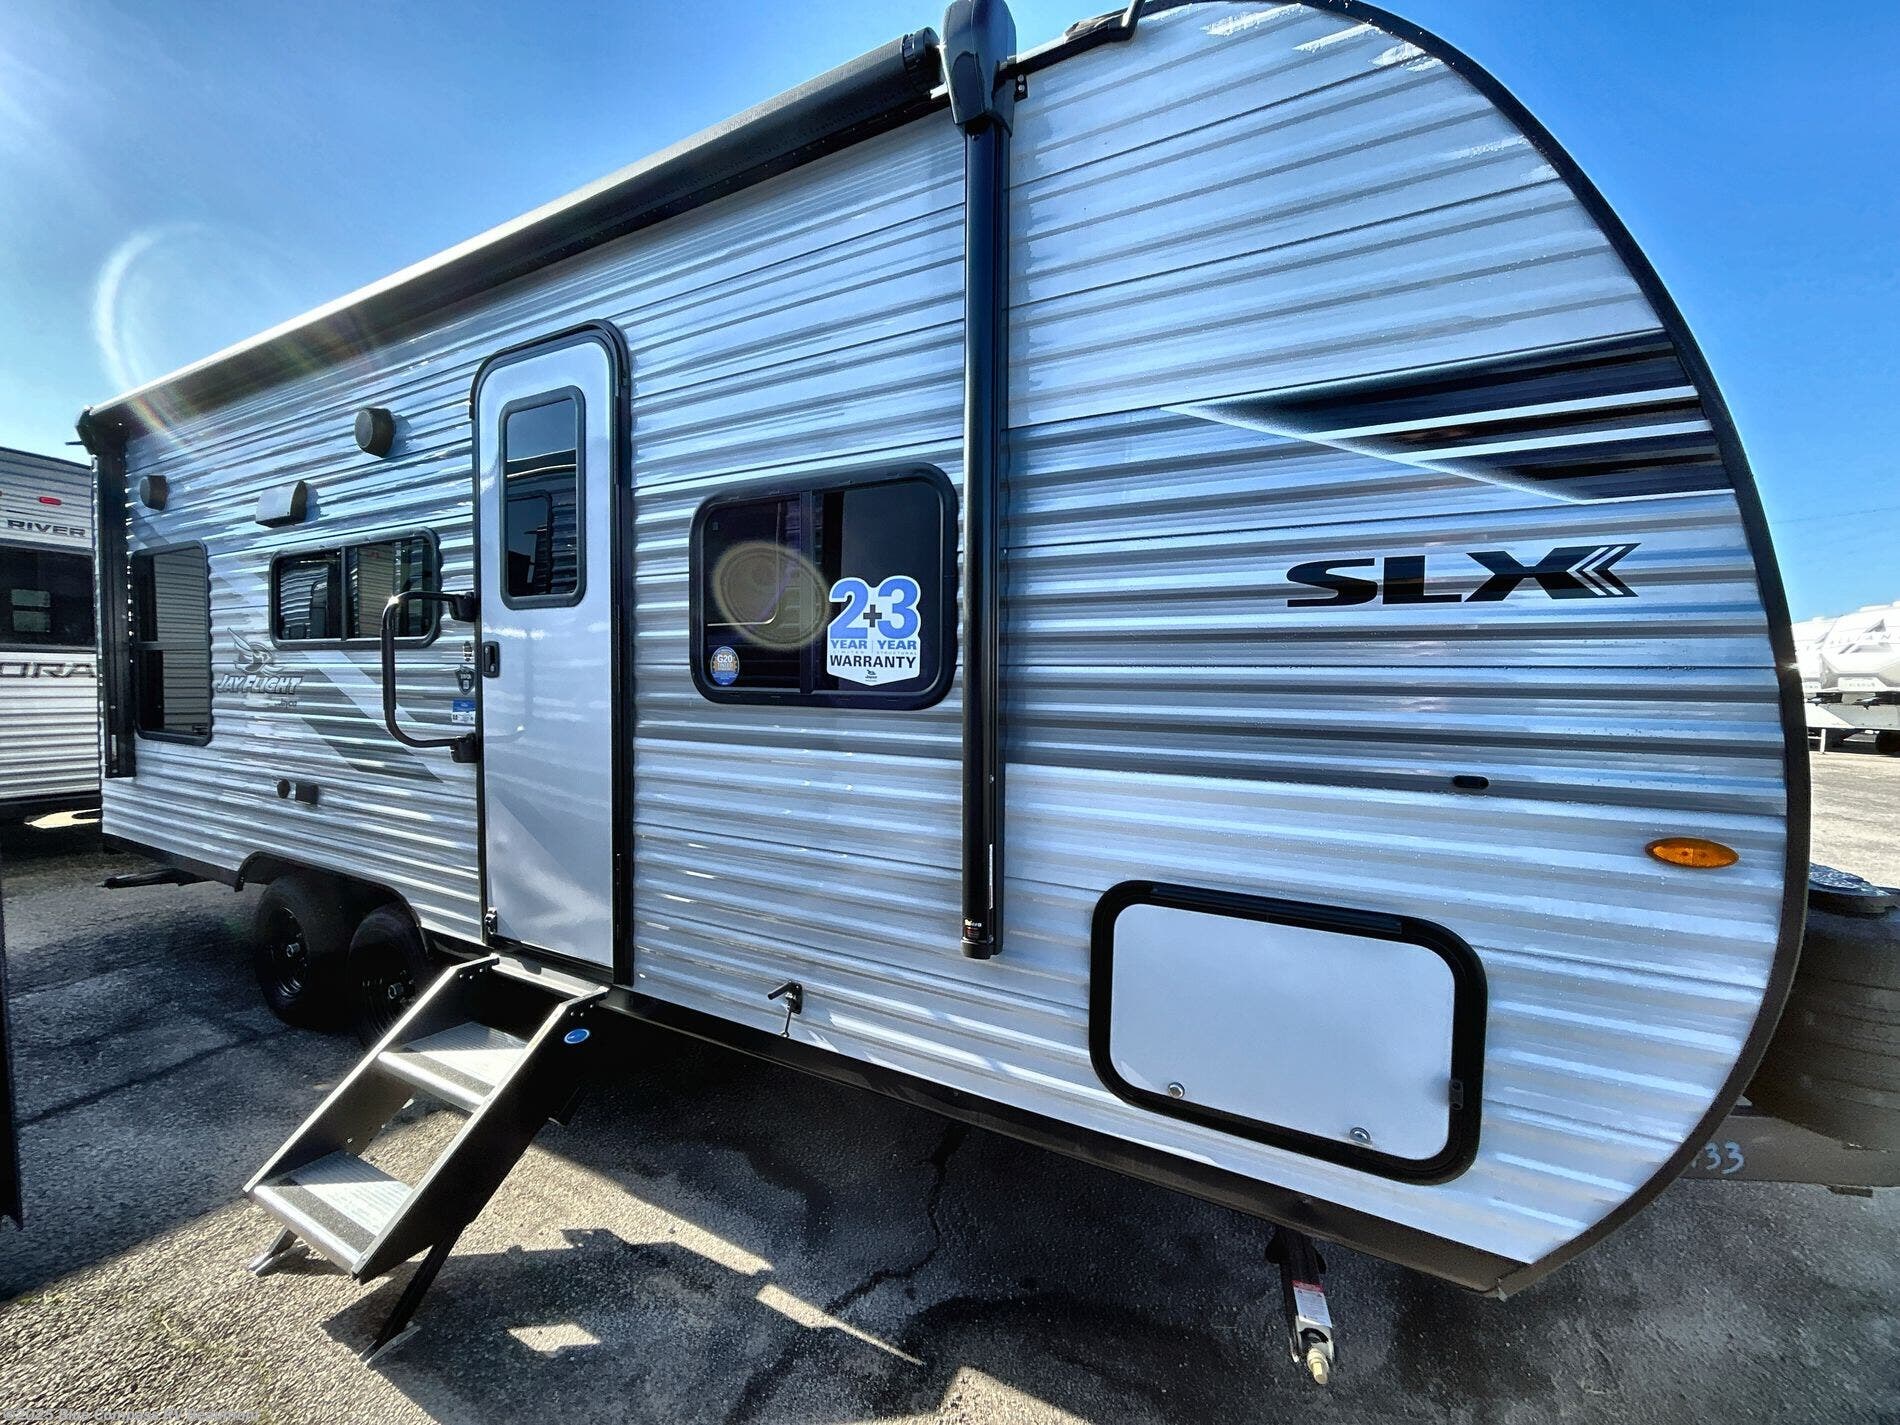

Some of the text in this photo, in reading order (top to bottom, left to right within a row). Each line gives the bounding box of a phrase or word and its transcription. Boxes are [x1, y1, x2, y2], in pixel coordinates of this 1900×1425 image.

[7, 519, 86, 538] RIVER
[1286, 542, 1641, 608] SLX
[831, 640, 917, 650] YEAR YEAR
[830, 654, 916, 669] WARRANTY
[1691, 1141, 1744, 1174] 33
